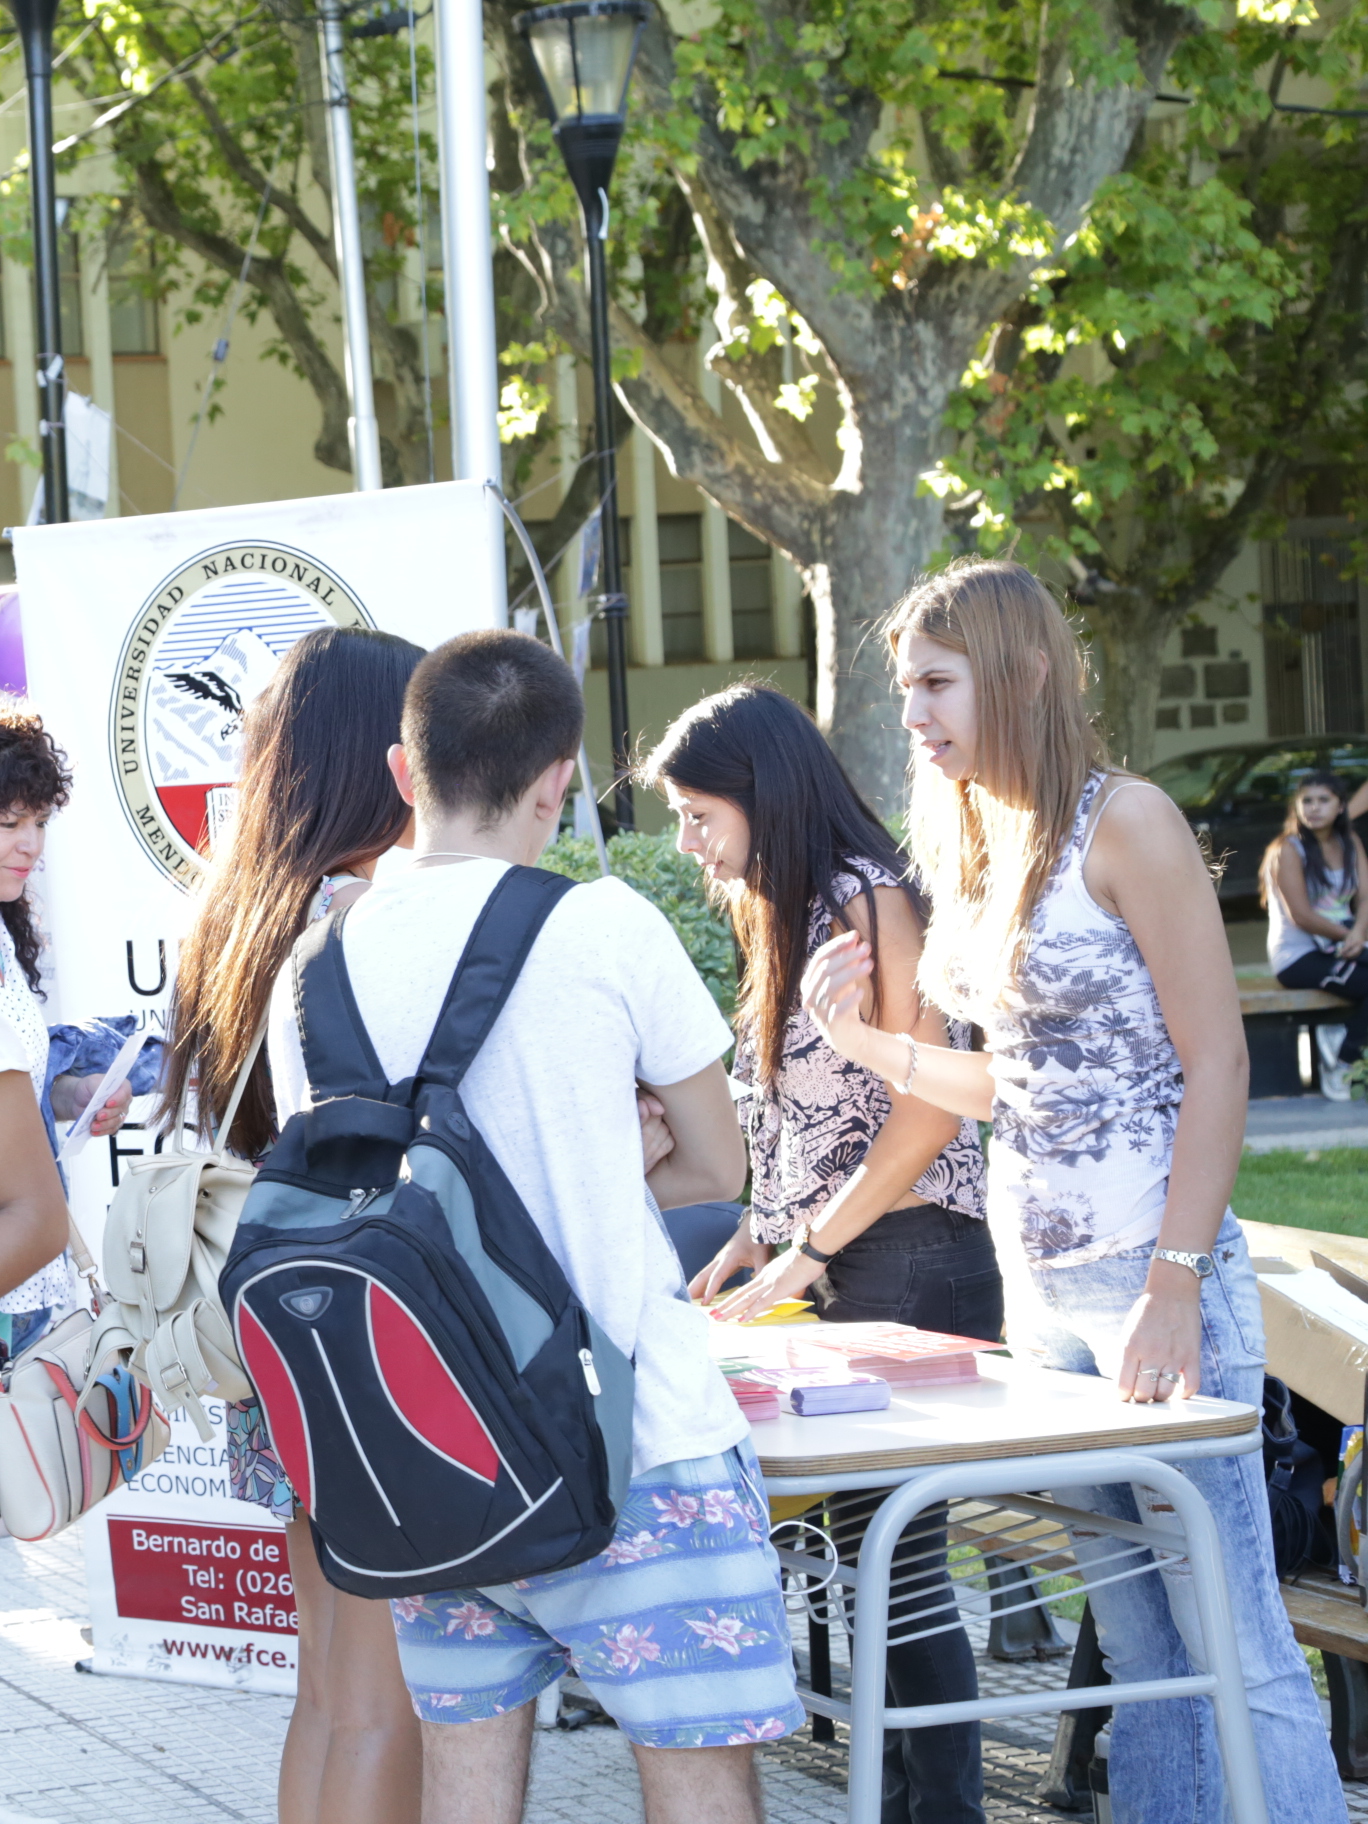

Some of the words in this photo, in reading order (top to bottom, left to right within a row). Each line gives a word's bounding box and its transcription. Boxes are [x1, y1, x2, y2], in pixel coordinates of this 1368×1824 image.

[120, 585, 185, 775] UNIVERSIDAD
[201, 552, 336, 607] NACIONAL
[154, 1444, 230, 1467] ENCIA
[127, 1472, 236, 1499] ECONOM
[132, 1529, 241, 1560] Bernardo
[249, 1539, 281, 1563] de
[182, 1564, 225, 1590] Tel:
[236, 1569, 294, 1597] (026
[181, 1596, 225, 1621] San
[234, 1603, 299, 1629] Rafae
[163, 1638, 296, 1670] www.fce.
